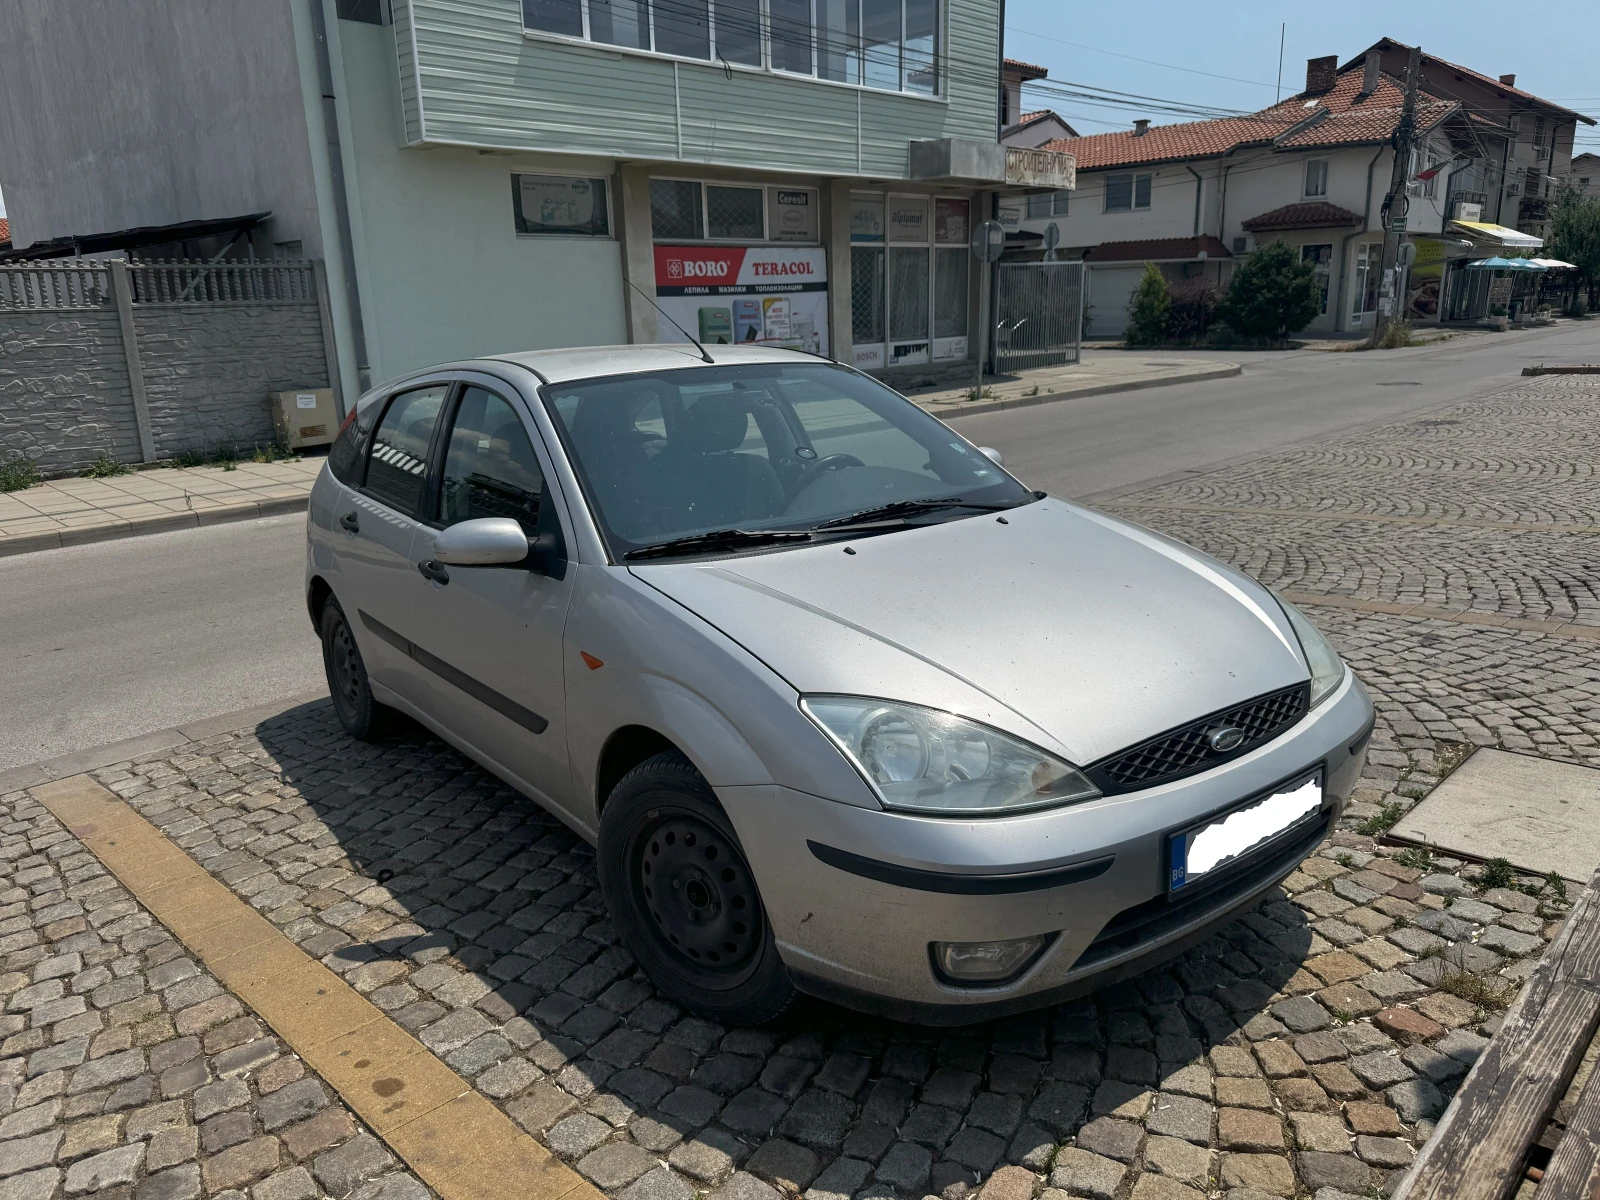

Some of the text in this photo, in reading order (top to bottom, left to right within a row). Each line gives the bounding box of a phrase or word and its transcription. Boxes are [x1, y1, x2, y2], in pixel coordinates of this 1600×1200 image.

[1008, 150, 1057, 174] СТРОИТЕЛНИ
[779, 193, 806, 204] Ceresit
[892, 209, 923, 225] Diplomat
[684, 261, 728, 277] BORO
[752, 262, 814, 276] TERACOL
[684, 284, 803, 294] ЛЕПИЛА МАЗИЛКИ ТОПЛОИЗОЛАЦИИ
[856, 351, 878, 361] BOSCH
[1172, 866, 1184, 881] BG
